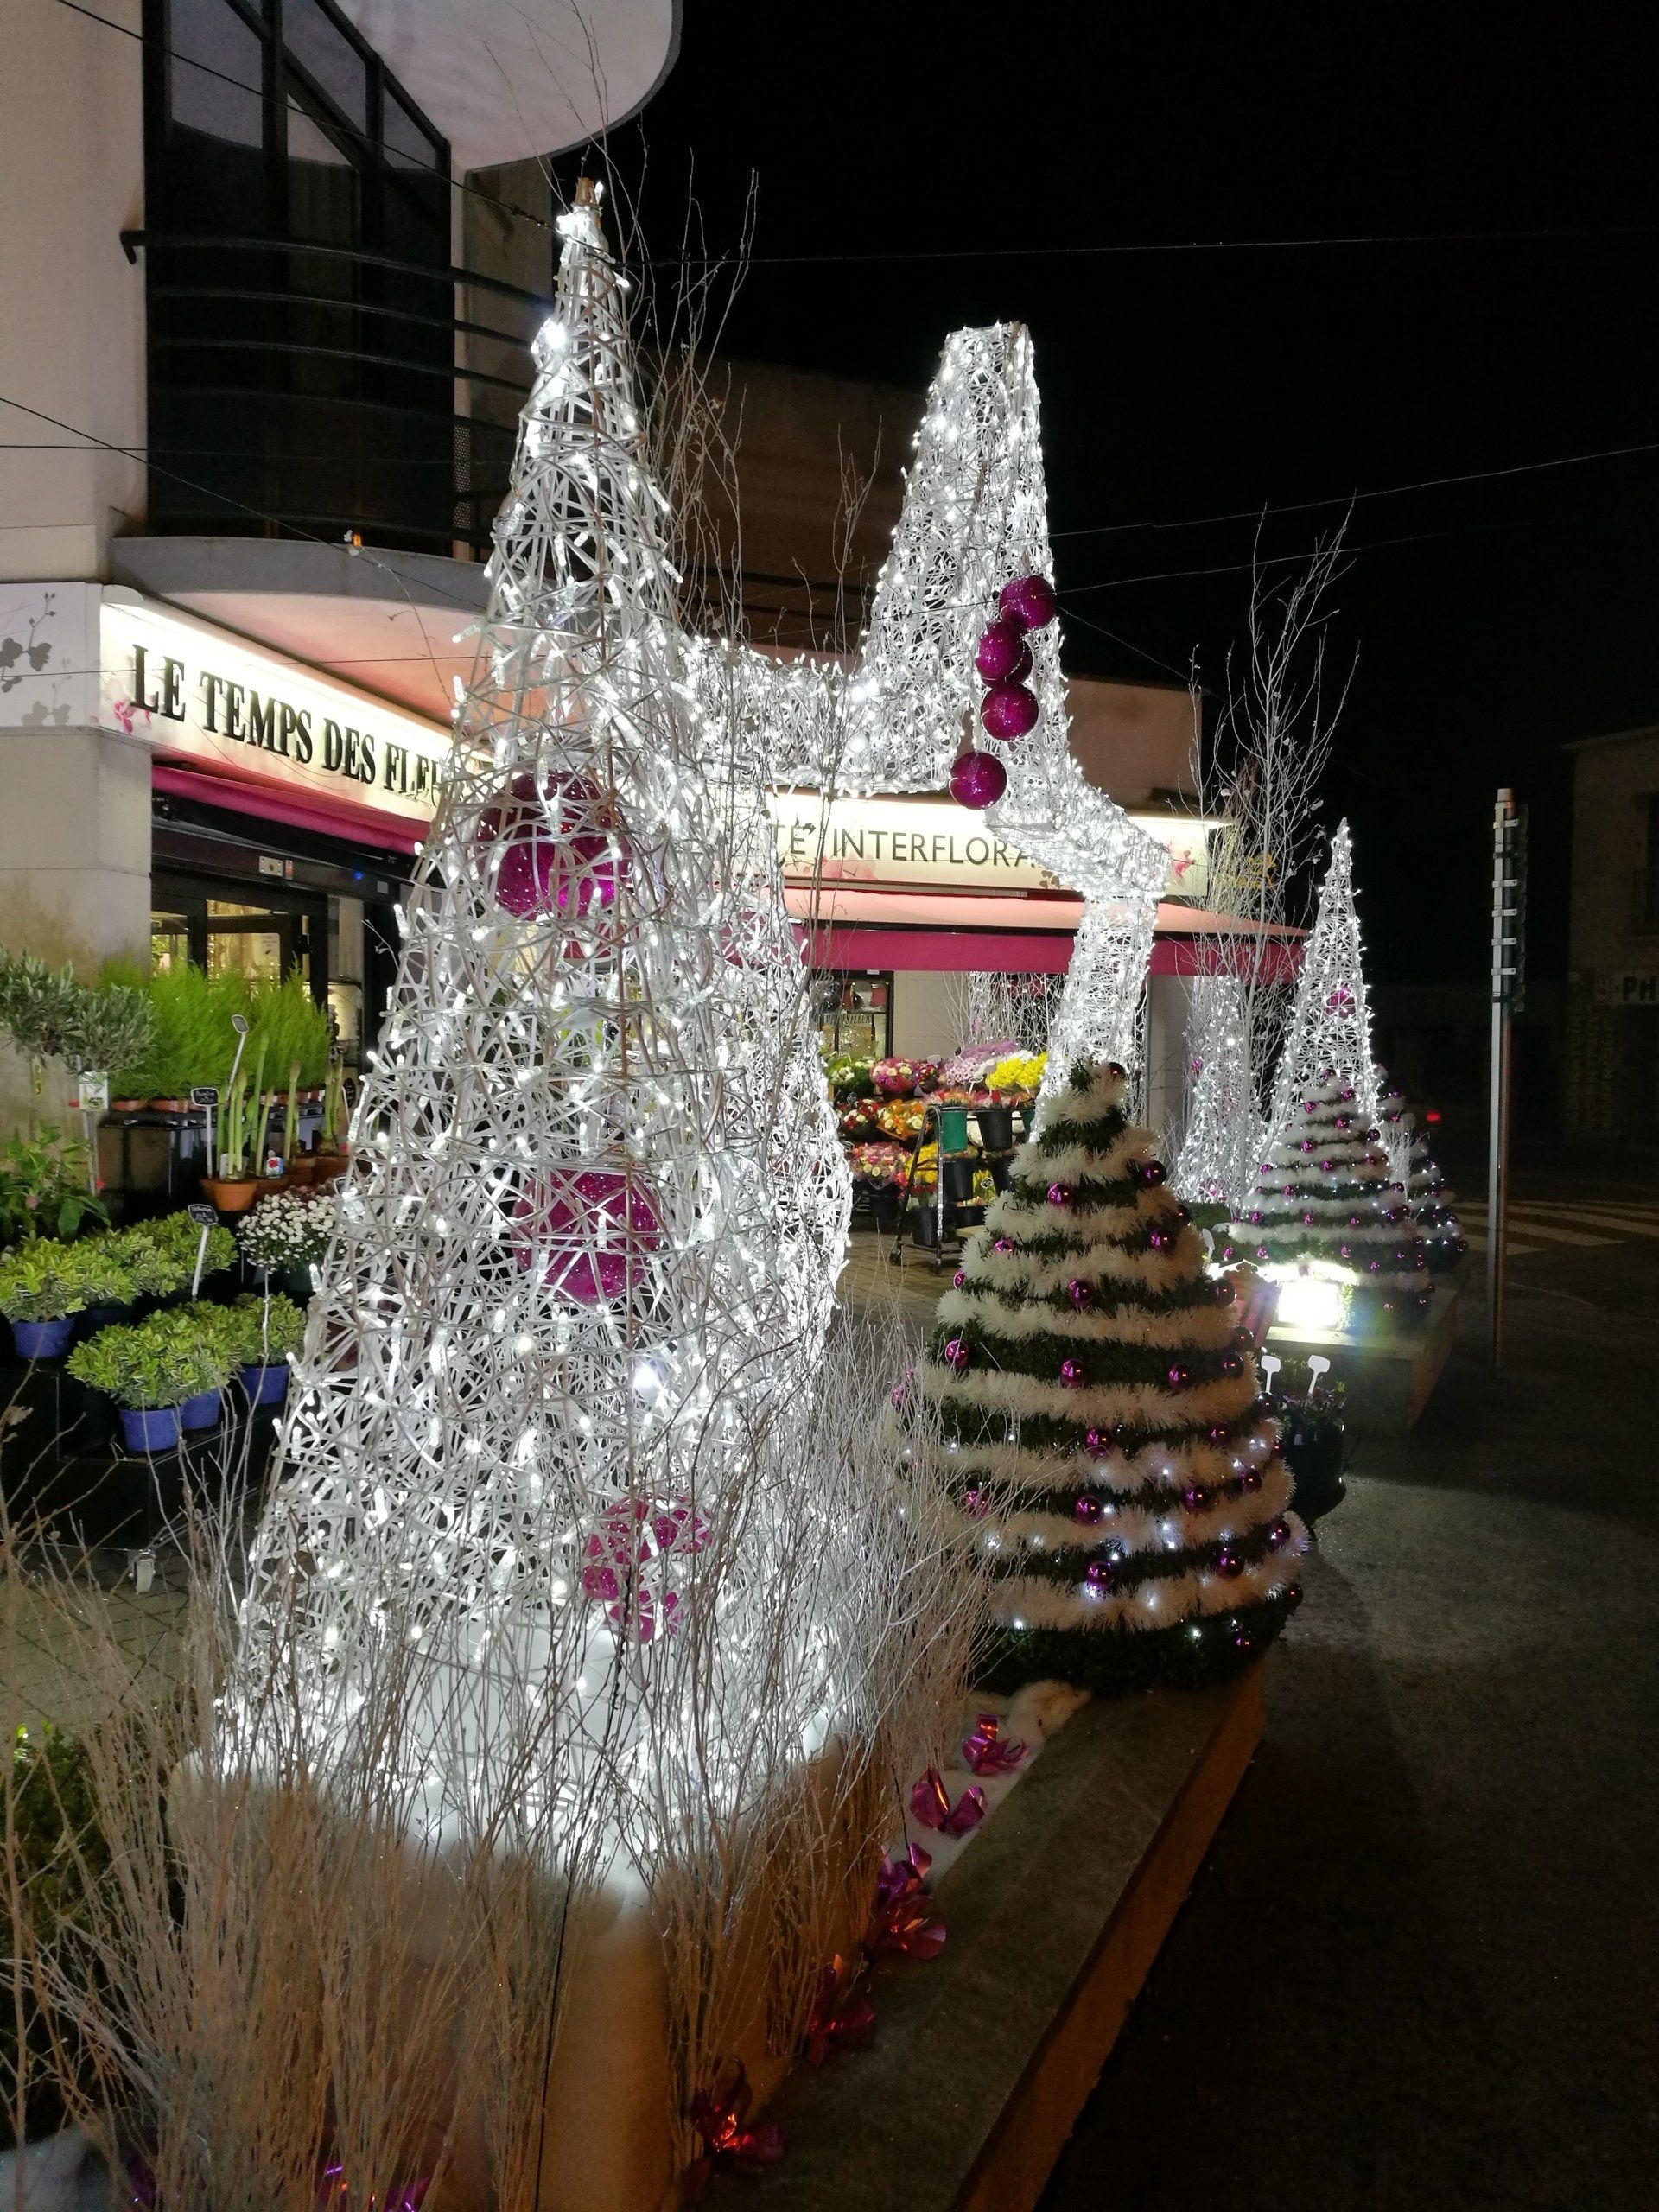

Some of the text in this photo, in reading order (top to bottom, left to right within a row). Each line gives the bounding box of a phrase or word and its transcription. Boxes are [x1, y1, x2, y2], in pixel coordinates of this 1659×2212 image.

[131, 643, 186, 722] LE
[199, 670, 313, 764] TEMPS
[321, 717, 376, 785] DES
